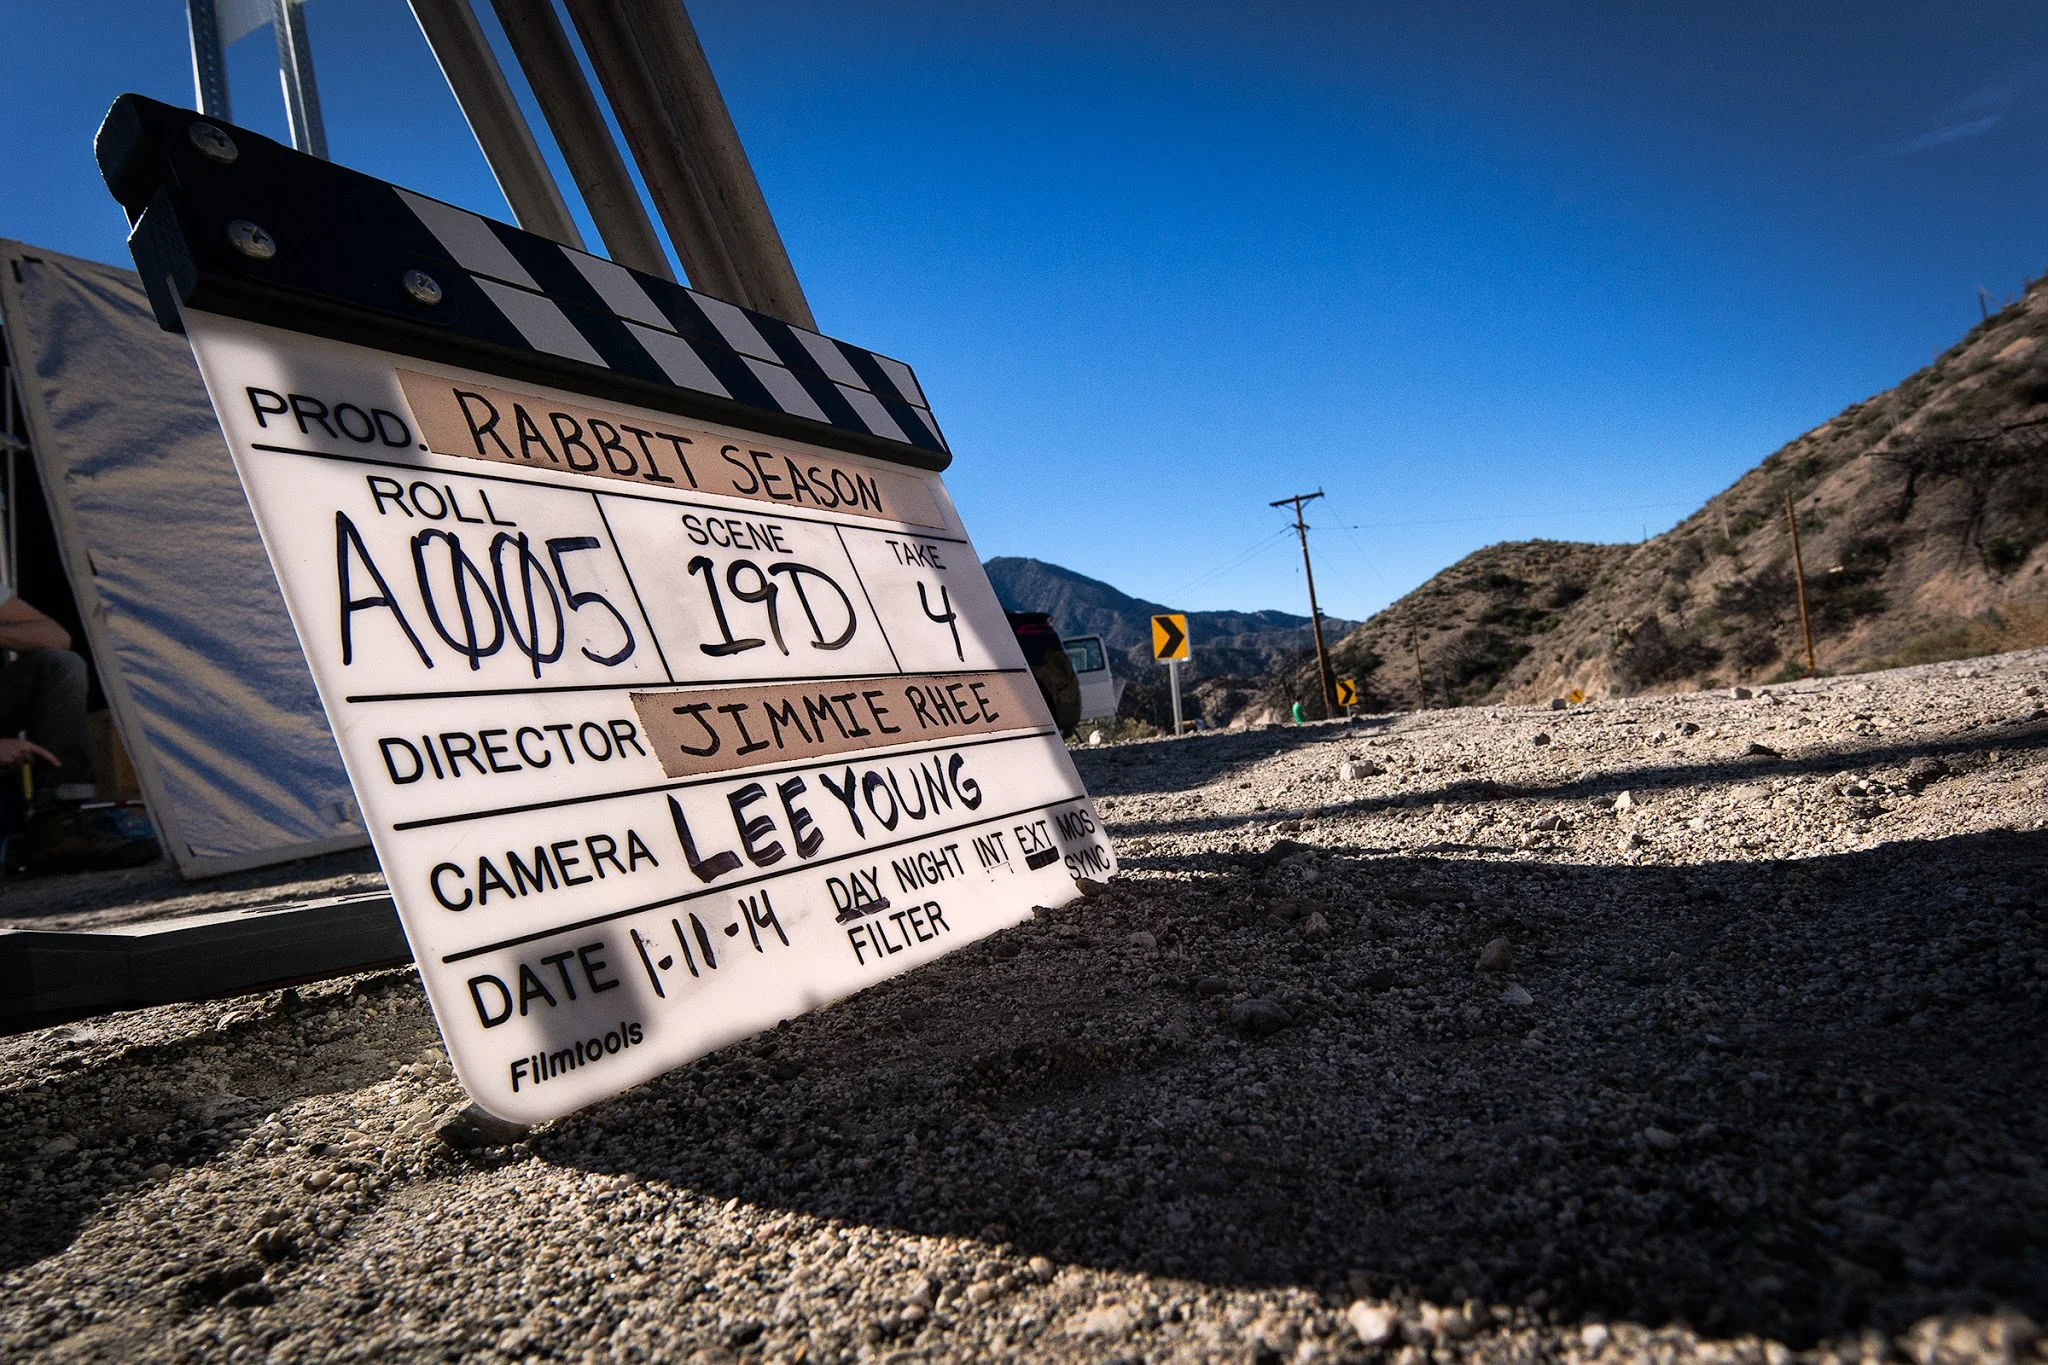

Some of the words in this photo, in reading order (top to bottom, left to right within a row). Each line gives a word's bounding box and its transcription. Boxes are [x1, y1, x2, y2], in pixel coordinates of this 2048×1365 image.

[246, 386, 429, 451] PROD.
[453, 388, 699, 489] RABBIT
[720, 445, 883, 513] SEASON
[366, 475, 517, 527] ROLL
[682, 514, 793, 554] SCENE
[885, 540, 947, 570] TAKE
[688, 556, 857, 657] 19D
[917, 581, 965, 662] 4
[378, 719, 647, 785] DIRECTOR
[673, 690, 900, 757] JIMMIE
[904, 682, 999, 730] RHEE
[666, 776, 824, 884] LEE
[819, 752, 982, 840] YOUNG
[429, 829, 660, 912] CAMERA
[826, 866, 884, 914] DAY
[891, 844, 965, 894] NIGHT
[972, 831, 1009, 868] INT
[1014, 820, 1054, 855] EXT
[1057, 810, 1096, 843] MOS
[1064, 845, 1110, 881] SYNC
[630, 889, 790, 999] 1-11-14
[847, 901, 950, 966] FILTER
[468, 942, 620, 1029] DATE
[510, 1021, 644, 1093] Filmtools
